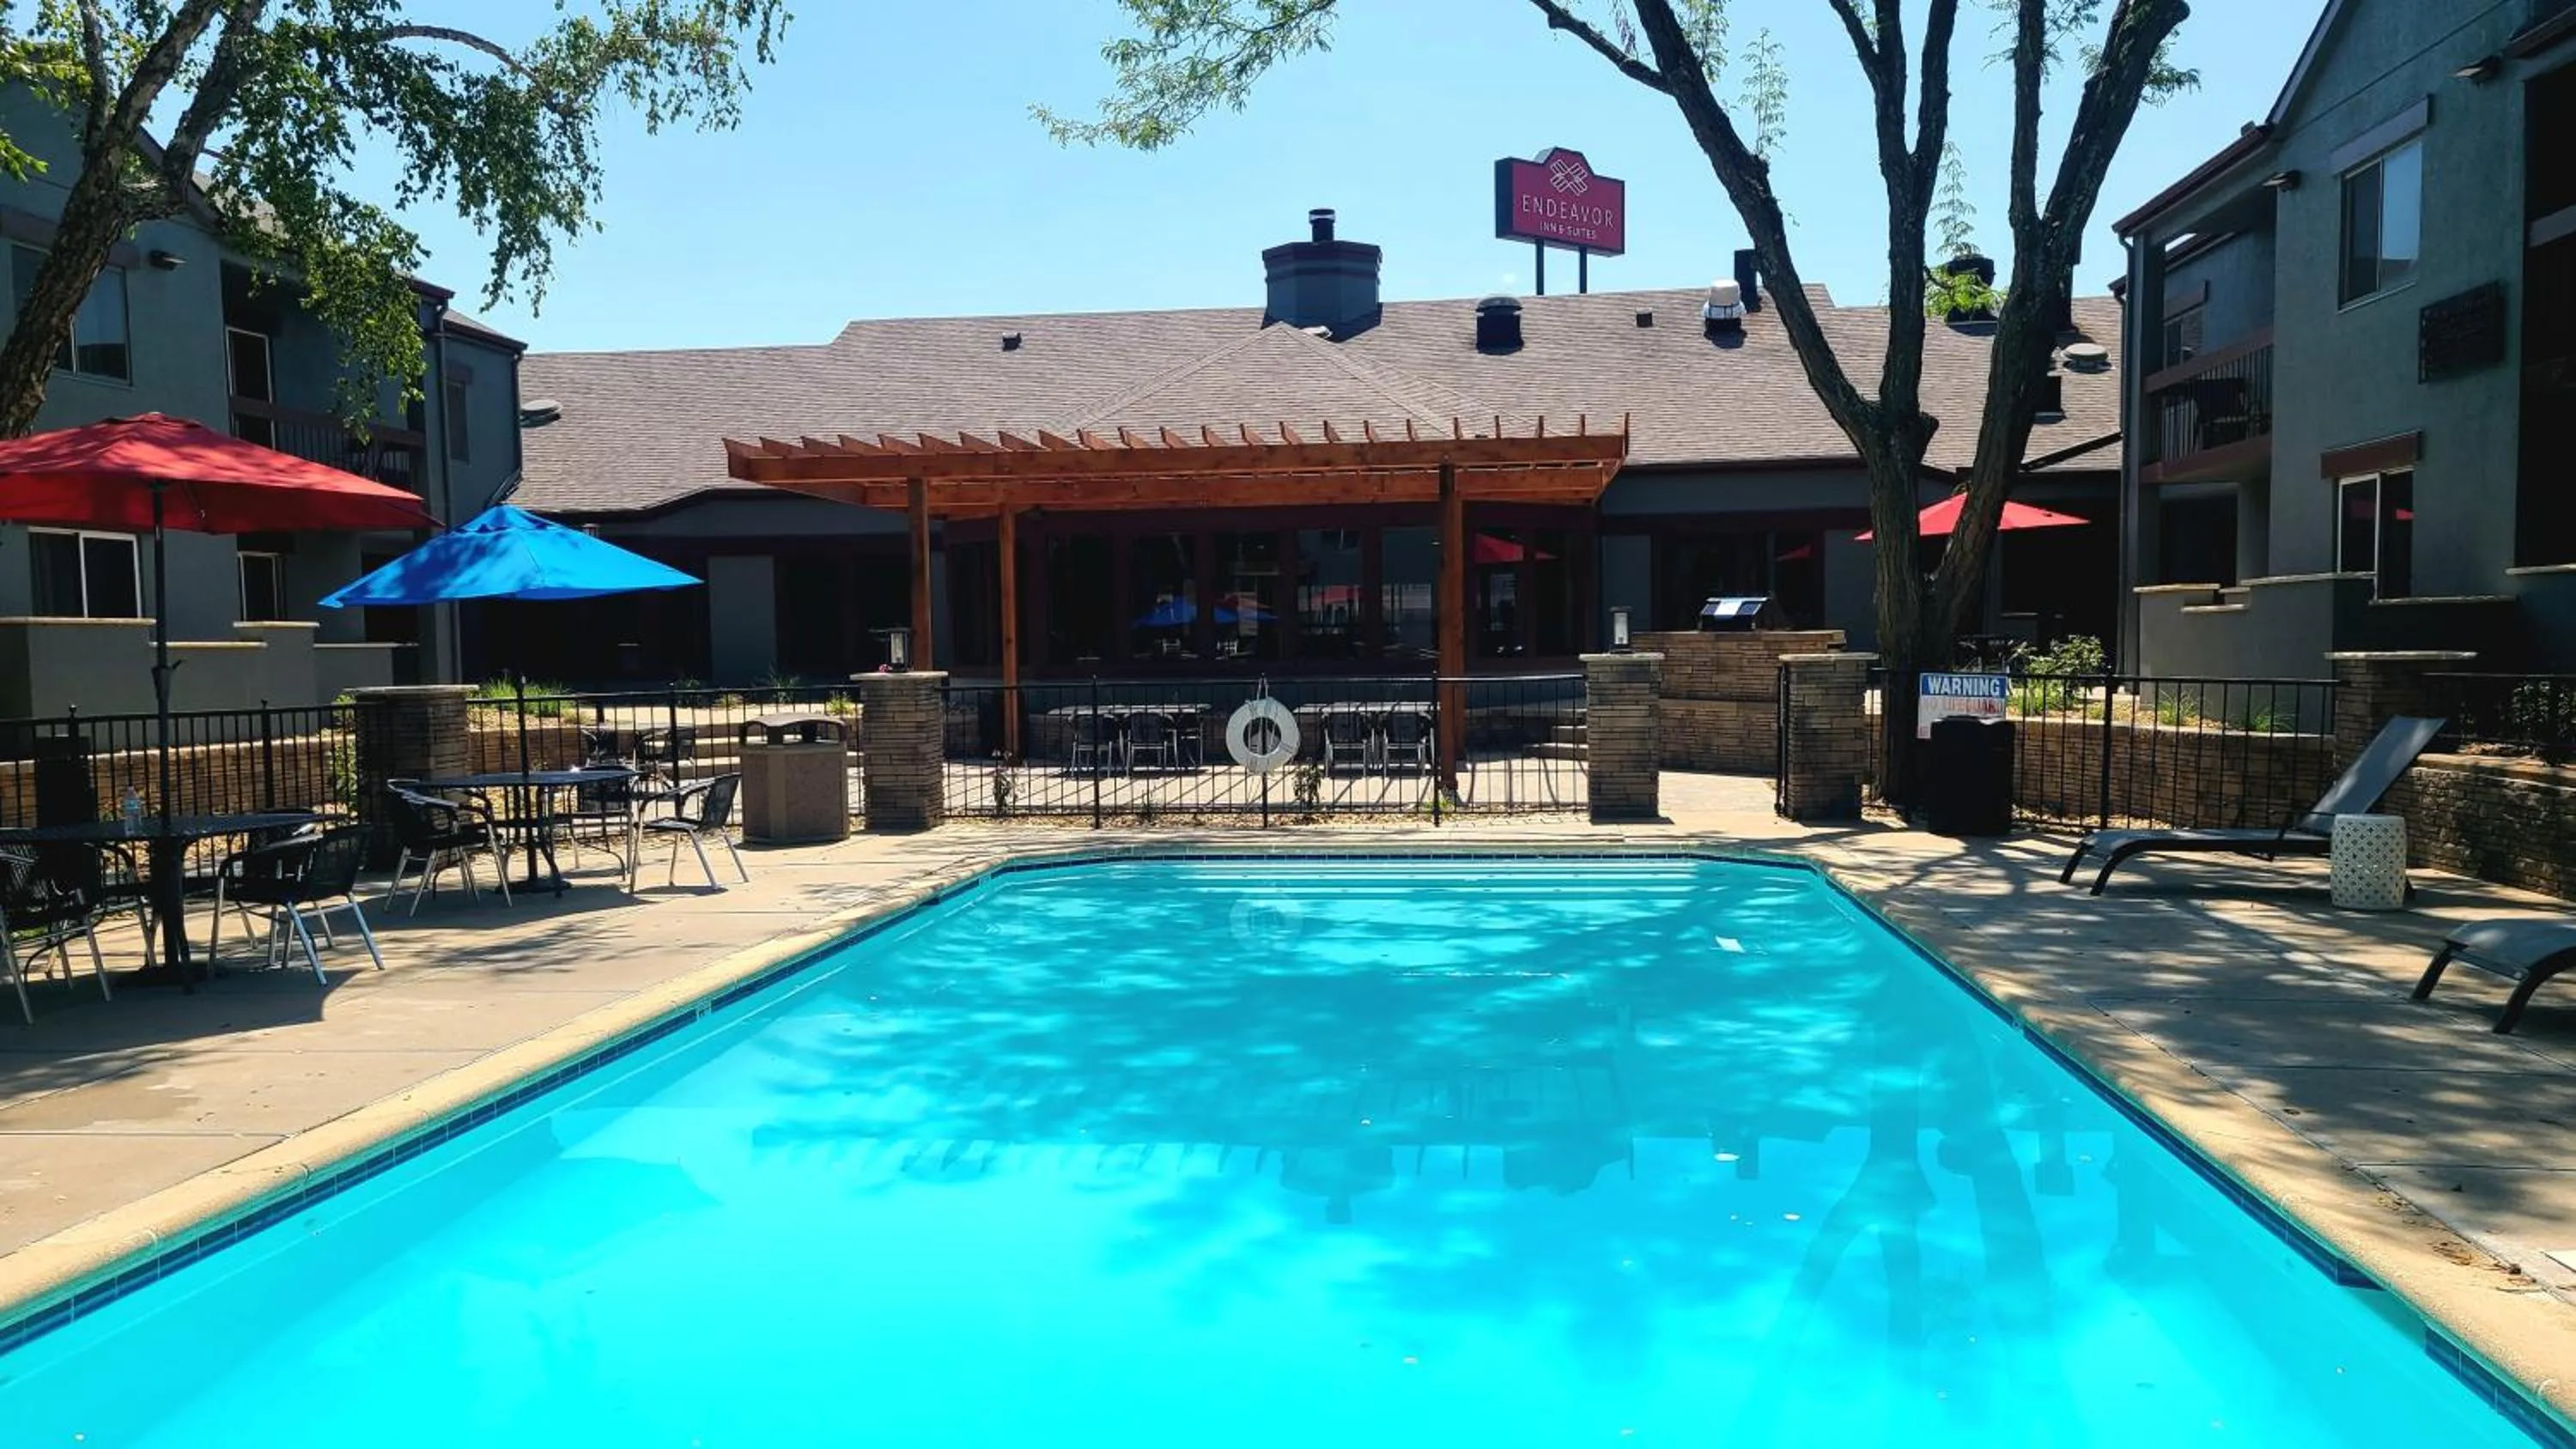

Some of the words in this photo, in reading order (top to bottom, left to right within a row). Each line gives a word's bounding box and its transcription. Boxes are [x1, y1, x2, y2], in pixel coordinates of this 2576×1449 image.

[1522, 194, 1614, 227] ENDEAVOR
[1540, 221, 1557, 232] INN
[1565, 225, 1596, 239] SUITES
[1928, 676, 2000, 696] WARNING
